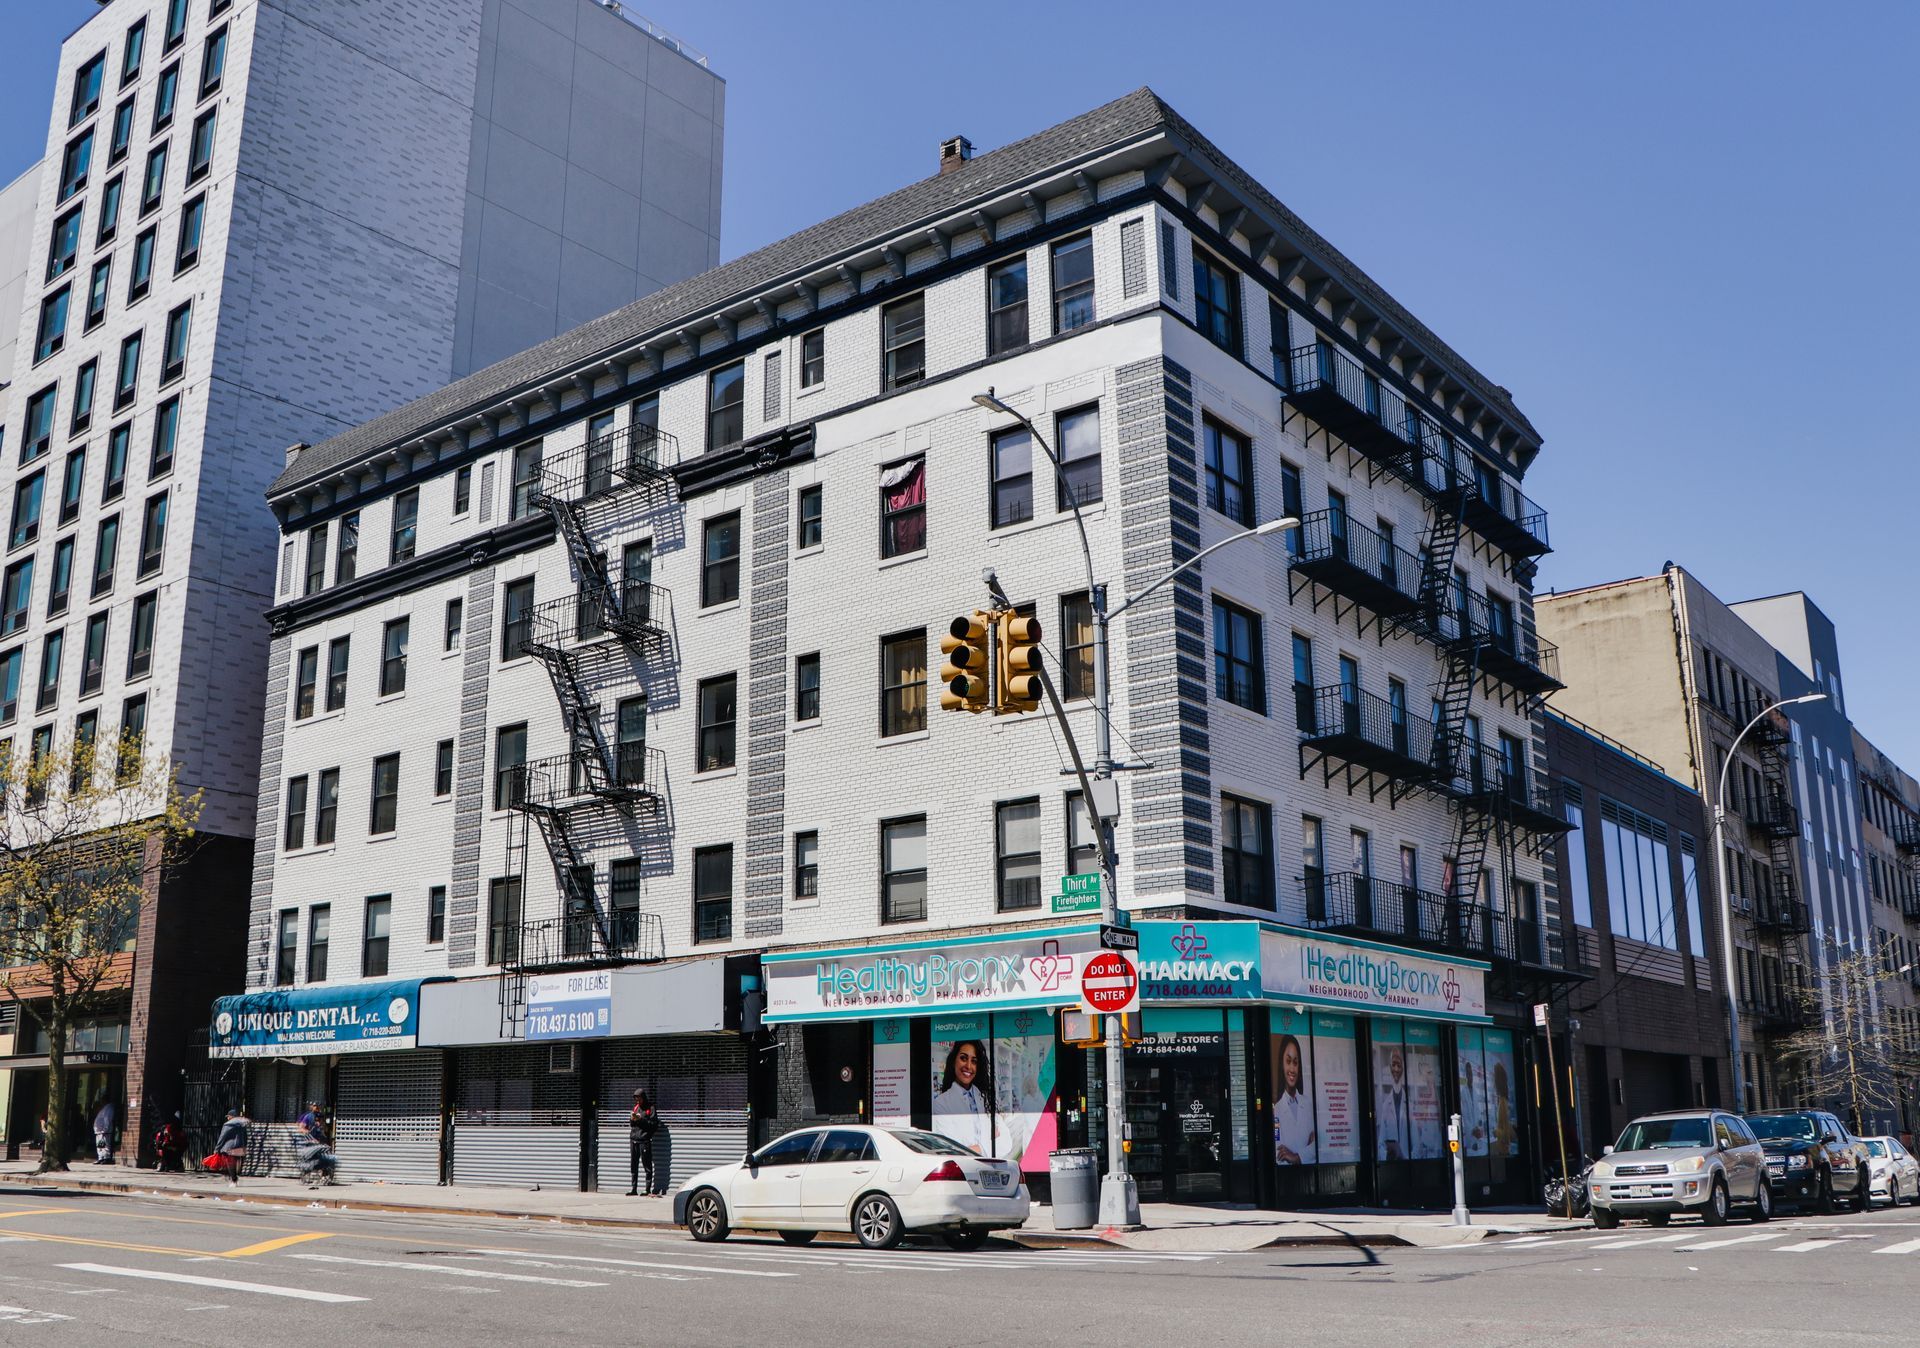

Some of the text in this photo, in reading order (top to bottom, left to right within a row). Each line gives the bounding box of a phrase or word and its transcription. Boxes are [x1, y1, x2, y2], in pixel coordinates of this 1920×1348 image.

[1066, 877, 1087, 891] Third
[1056, 895, 1097, 907] Firefighters
[1105, 932, 1134, 945] ONE WAY
[1091, 964, 1126, 975] DO NOT
[1138, 961, 1255, 981] HARMACY
[568, 977, 583, 992] FOR
[584, 975, 609, 991] LEASE
[1094, 991, 1125, 1001] ENTER
[1146, 984, 1233, 997] 718.684.4044
[1309, 985, 1419, 1006] NEIGHBORHOOD PHARMACY
[825, 987, 998, 1008] NEIGHBORHOOD PHARMACY
[237, 1011, 293, 1033] UNIQUE
[365, 1013, 380, 1023] P.C.
[530, 1012, 594, 1034] 718.437.6100
[277, 1030, 336, 1042] WALK-INS WELCOME
[1158, 1036, 1176, 1044] AVE
[1182, 1035, 1211, 1044] STORE
[1212, 1035, 1218, 1043] C
[314, 1041, 348, 1053] INSURANCE
[349, 1040, 369, 1051] PLANS
[370, 1038, 403, 1049] ACCEPTED
[1136, 1045, 1197, 1054] 718-684-4044
